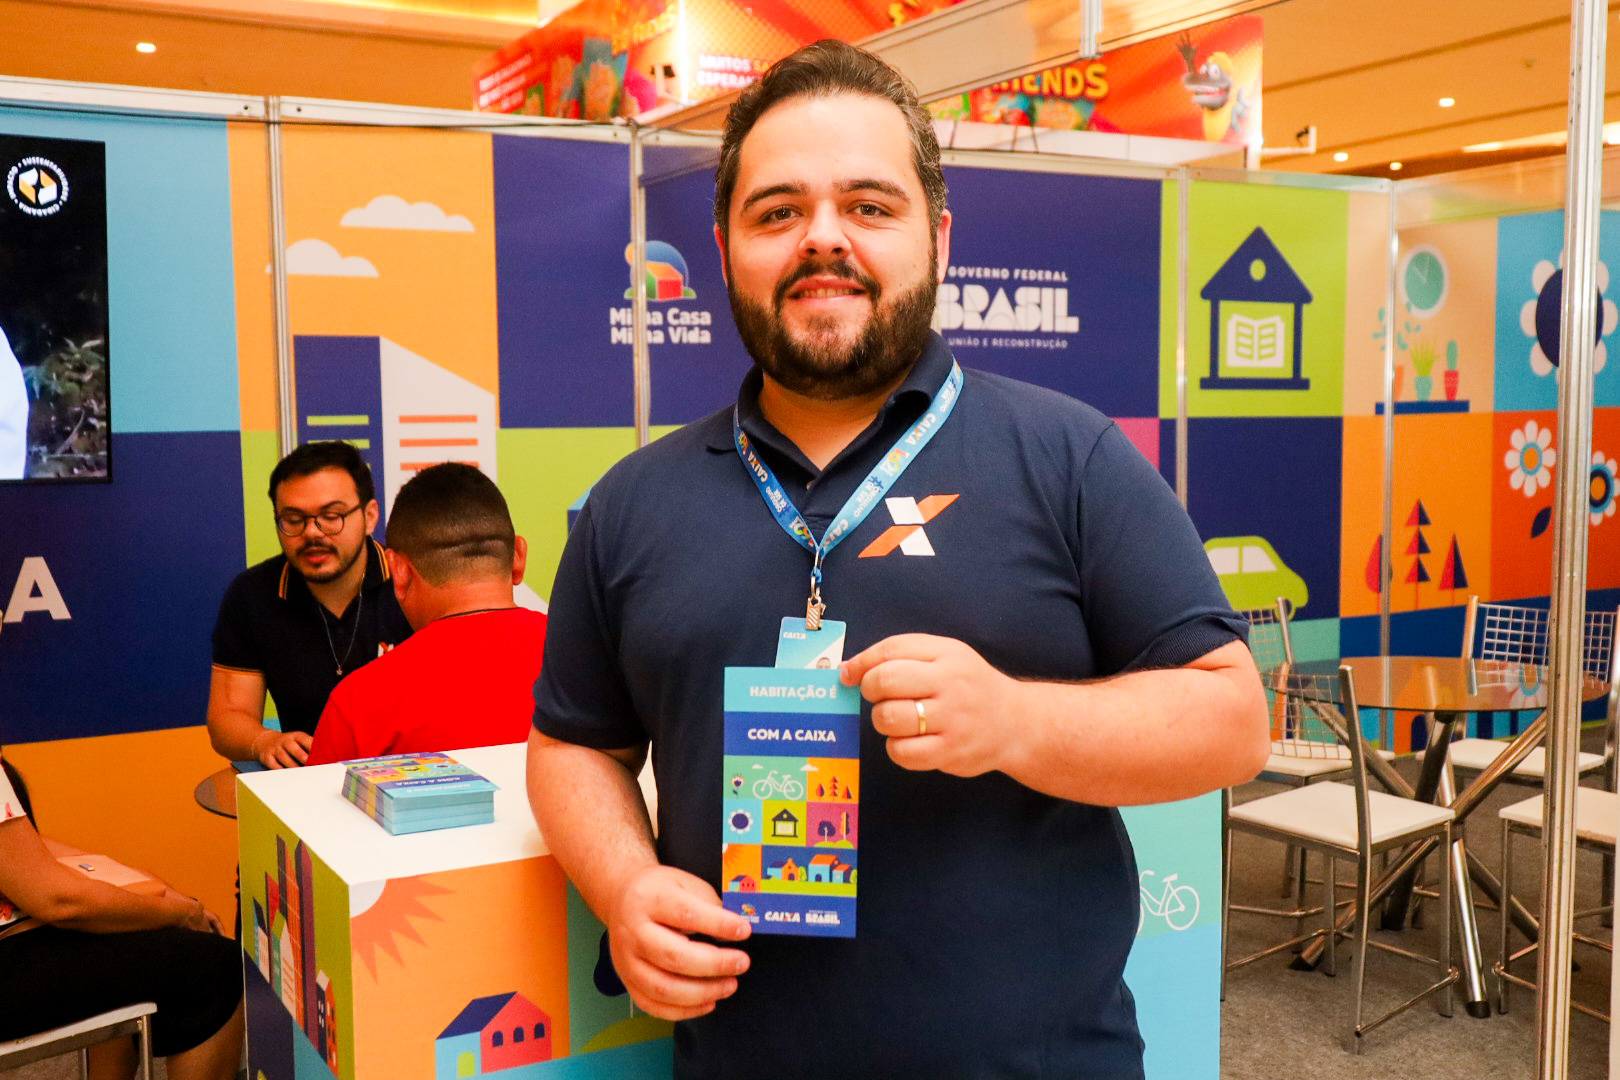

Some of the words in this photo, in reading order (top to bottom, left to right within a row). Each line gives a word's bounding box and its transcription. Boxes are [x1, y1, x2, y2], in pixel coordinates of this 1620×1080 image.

[948, 266, 1010, 280] GOVERNO
[1014, 269, 1069, 282] FEDERAL
[610, 307, 664, 325] Mia
[667, 307, 712, 325] Casa
[610, 327, 665, 344] Mia
[668, 327, 712, 343] Vida
[949, 336, 980, 346] UNIÃO
[983, 337, 988, 346] E
[992, 338, 1068, 348] RECONSTRUÇÃO
[904, 413, 936, 445] CAIXA
[748, 451, 768, 482] CAIXA
[3, 556, 72, 623] A
[783, 632, 806, 640] CAIXA
[750, 685, 827, 700] HABITAÇÃO
[829, 685, 837, 698] É
[747, 728, 779, 741] COM
[782, 730, 792, 741] A
[795, 730, 837, 742] CAIXA
[764, 911, 800, 923] CAIXA
